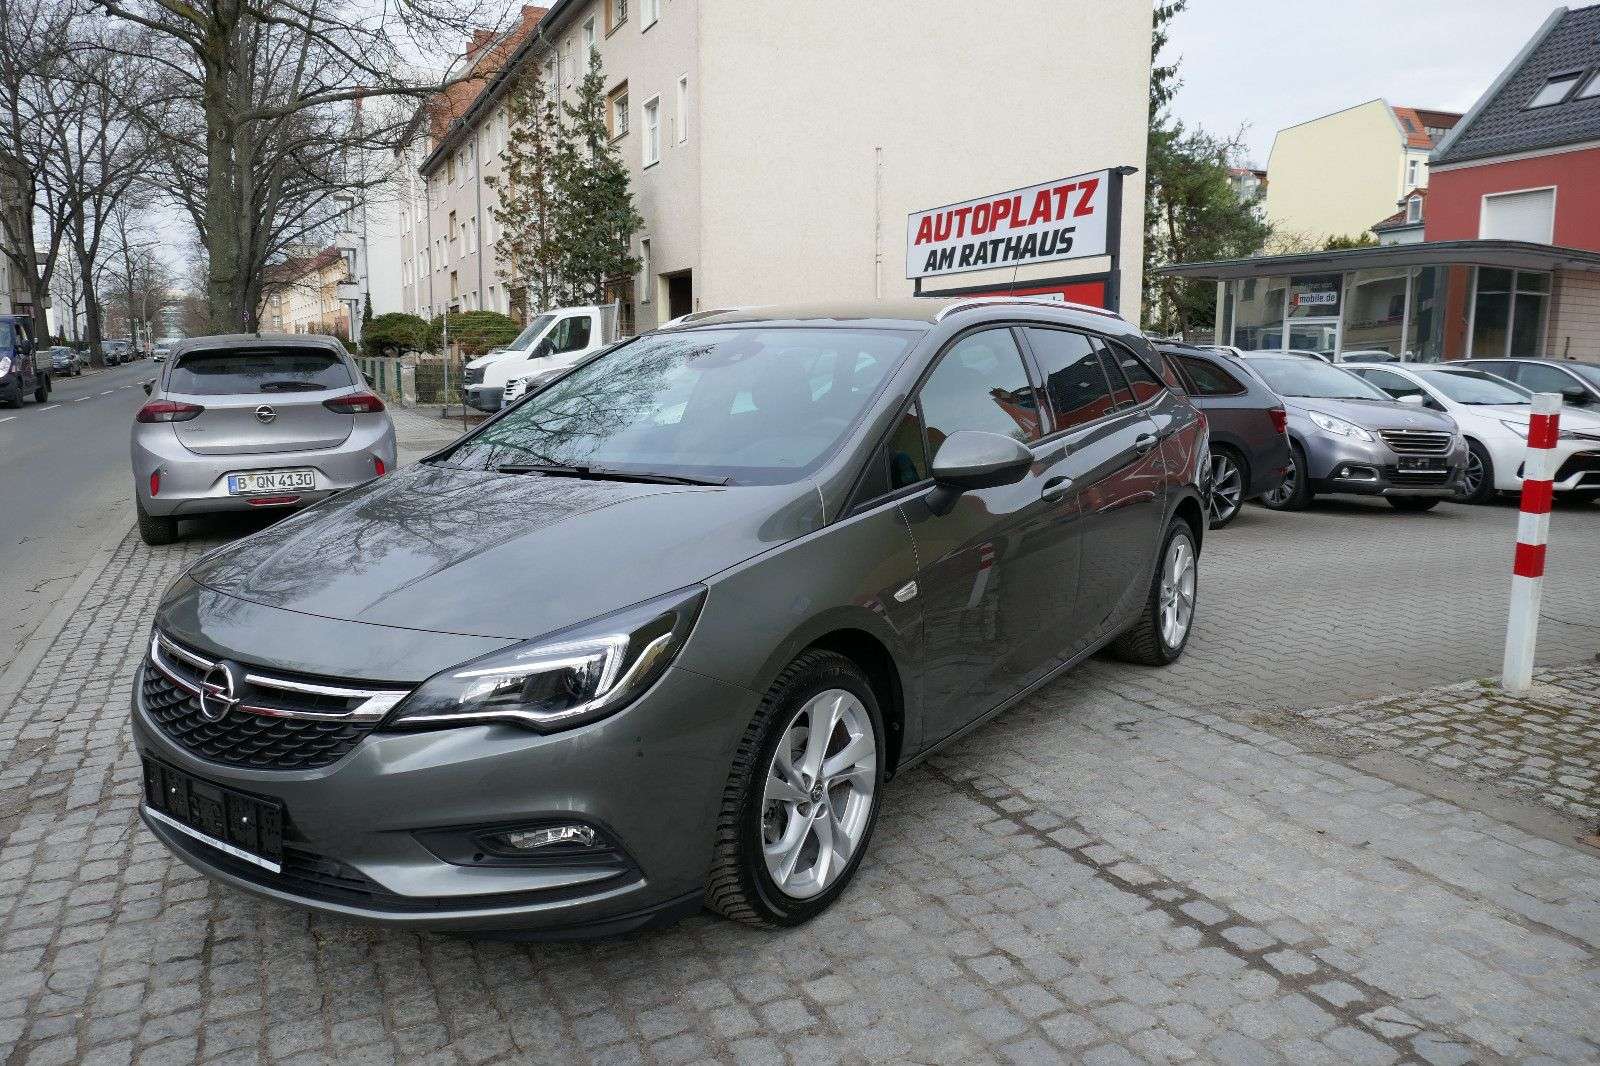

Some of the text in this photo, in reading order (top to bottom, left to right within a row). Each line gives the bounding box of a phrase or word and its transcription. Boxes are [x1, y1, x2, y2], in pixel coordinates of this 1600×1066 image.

[914, 178, 1100, 246] AUTOPLATZ
[923, 226, 1076, 273] AM RATHAUS
[1299, 293, 1336, 303] mobile.de
[237, 473, 312, 490] B QN 4130
